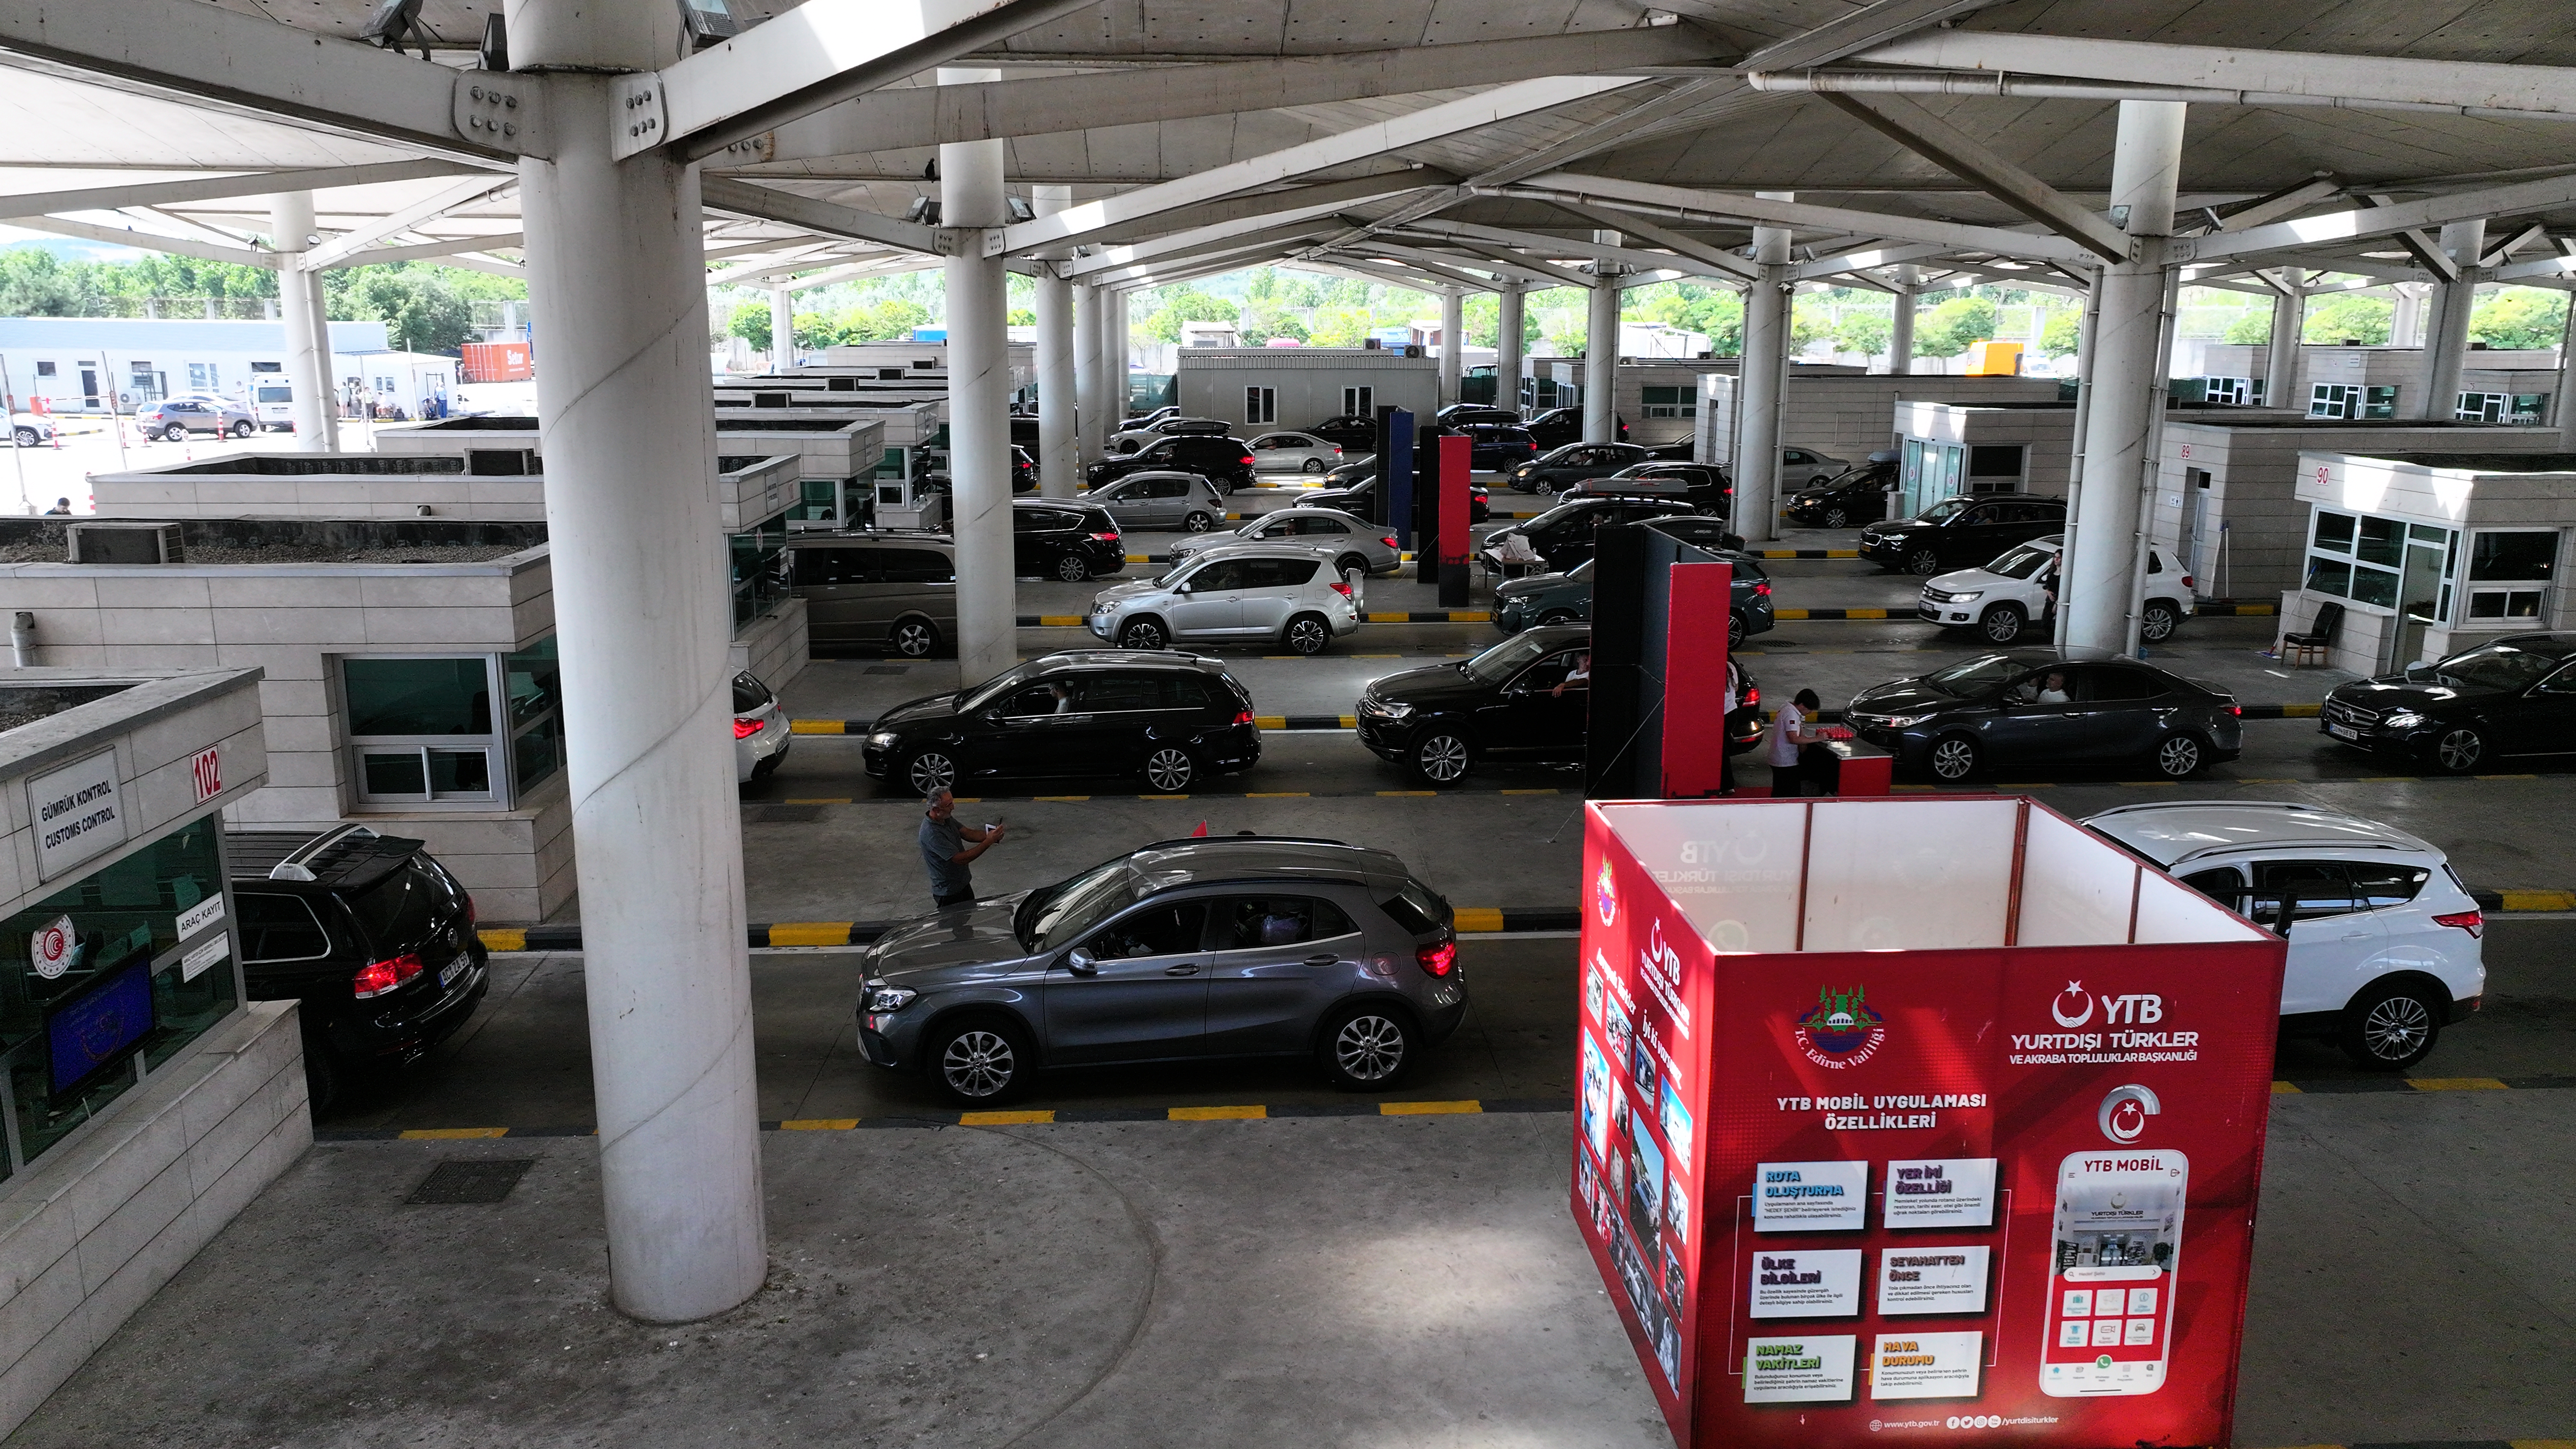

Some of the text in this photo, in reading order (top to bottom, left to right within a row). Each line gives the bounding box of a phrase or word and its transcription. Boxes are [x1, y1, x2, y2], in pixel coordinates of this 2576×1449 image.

[507, 349, 523, 365] Setur
[2182, 444, 2190, 458] 89
[2317, 467, 2328, 484] 90
[194, 750, 221, 799] 102
[41, 780, 112, 822] GÜMRÜK KONTROL
[45, 805, 115, 849] CUSTOMS CONTROL
[181, 901, 221, 933] ARAÇ KAYIT
[1664, 941, 1680, 986] YTB
[2101, 994, 2163, 1024] YTB
[1650, 1027, 1658, 1048] ki
[2011, 1029, 2199, 1051] YURTDIŞI TÜRKLER
[1795, 1027, 1885, 1069] T.C. Edirne Valiliği
[2009, 1049, 2197, 1064] VE AKRABA TOPLULUKLAR BAŞKANLIĞI
[1777, 1092, 1986, 1111] YTB MOBİL UYGULAMASI
[1825, 1111, 1936, 1130] ÖZELLİKLERİ
[2084, 1155, 2164, 1172] YTB MOBİL
[1766, 1170, 1800, 1182] ROTA
[1897, 1167, 1922, 1180] YER
[1766, 1185, 1844, 1200] OLUŞTURMA
[1761, 1256, 1796, 1270] ÜLKE
[1890, 1254, 1966, 1267] SEYAHATTEN
[1889, 1269, 1921, 1282] ÖNCE
[1756, 1344, 1804, 1356] NAMAZ
[1755, 1355, 1821, 1370] VAKİTLERİ
[1882, 1355, 1934, 1367] DURUMU
[1884, 1420, 1940, 1429] www.ytb.gov.tr
[2001, 1416, 2058, 1426] /yurtdisiturkler
